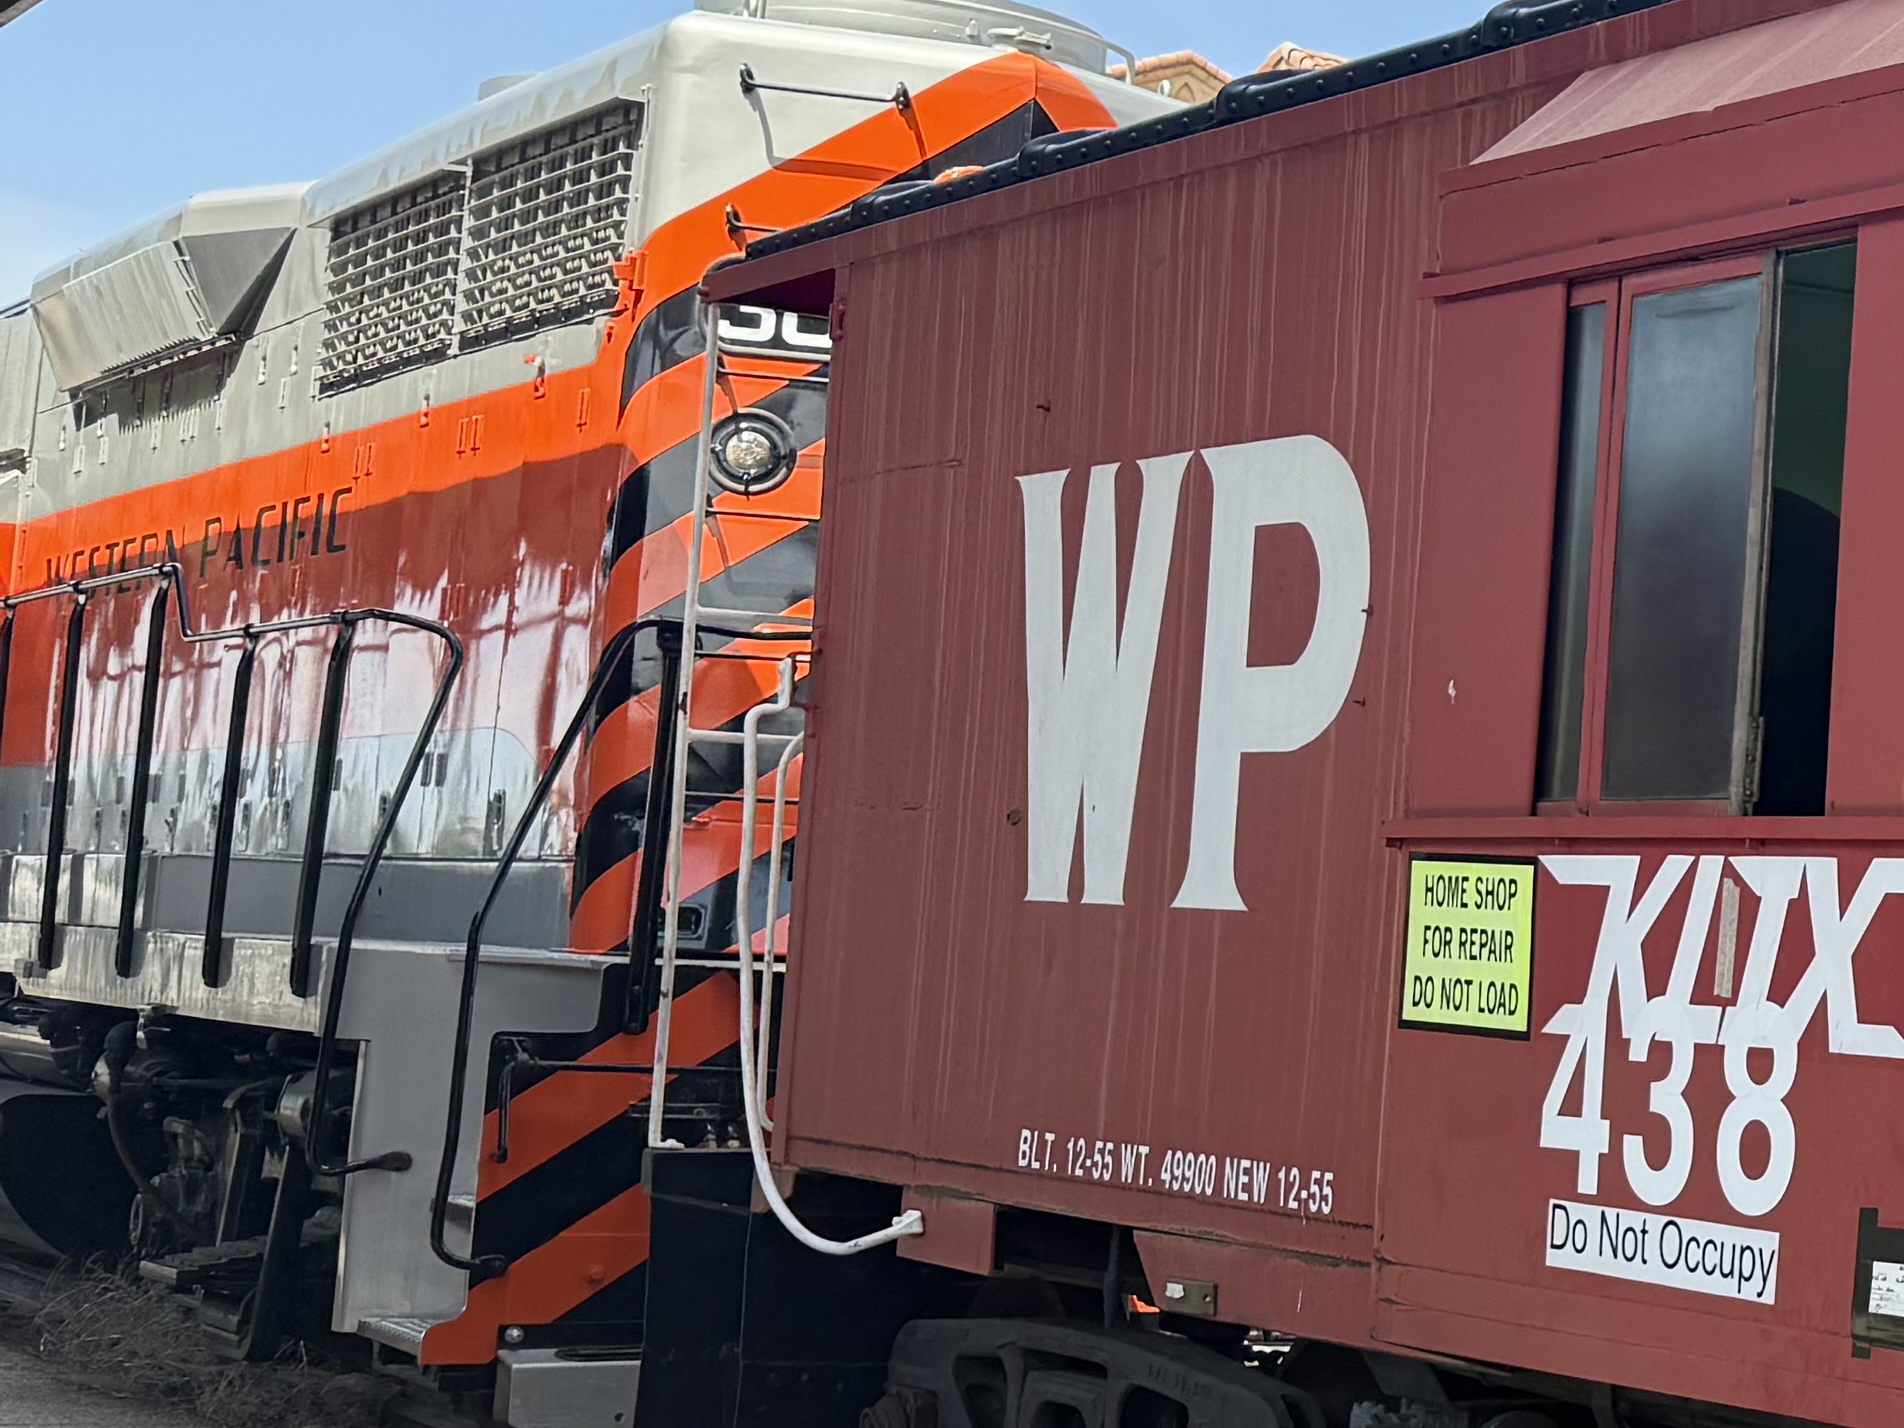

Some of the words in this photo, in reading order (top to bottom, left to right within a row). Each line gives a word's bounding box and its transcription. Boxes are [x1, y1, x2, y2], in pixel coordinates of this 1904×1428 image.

[200, 486, 353, 578] PACIFIC
[1015, 434, 1371, 911] WP
[1424, 874, 1470, 909] HOME
[1474, 876, 1518, 911] SHOP
[1422, 925, 1453, 960] FOR
[1458, 927, 1514, 964] REPAIR
[1411, 975, 1435, 1009] DO
[1440, 977, 1474, 1012] NOT
[1477, 980, 1519, 1016] LOAD
[1540, 995, 1799, 1217] 438
[1018, 1128, 1057, 1173] BLT.
[1066, 1137, 1114, 1182] 12-55
[1121, 1143, 1153, 1188] WT.
[1160, 1149, 1218, 1197] 49900
[1223, 1157, 1271, 1205] NEW
[1277, 1166, 1335, 1215] 12-55
[1550, 1203, 1588, 1254] Do
[1600, 1209, 1648, 1265] Not
[1659, 1218, 1777, 1299] Occupy
